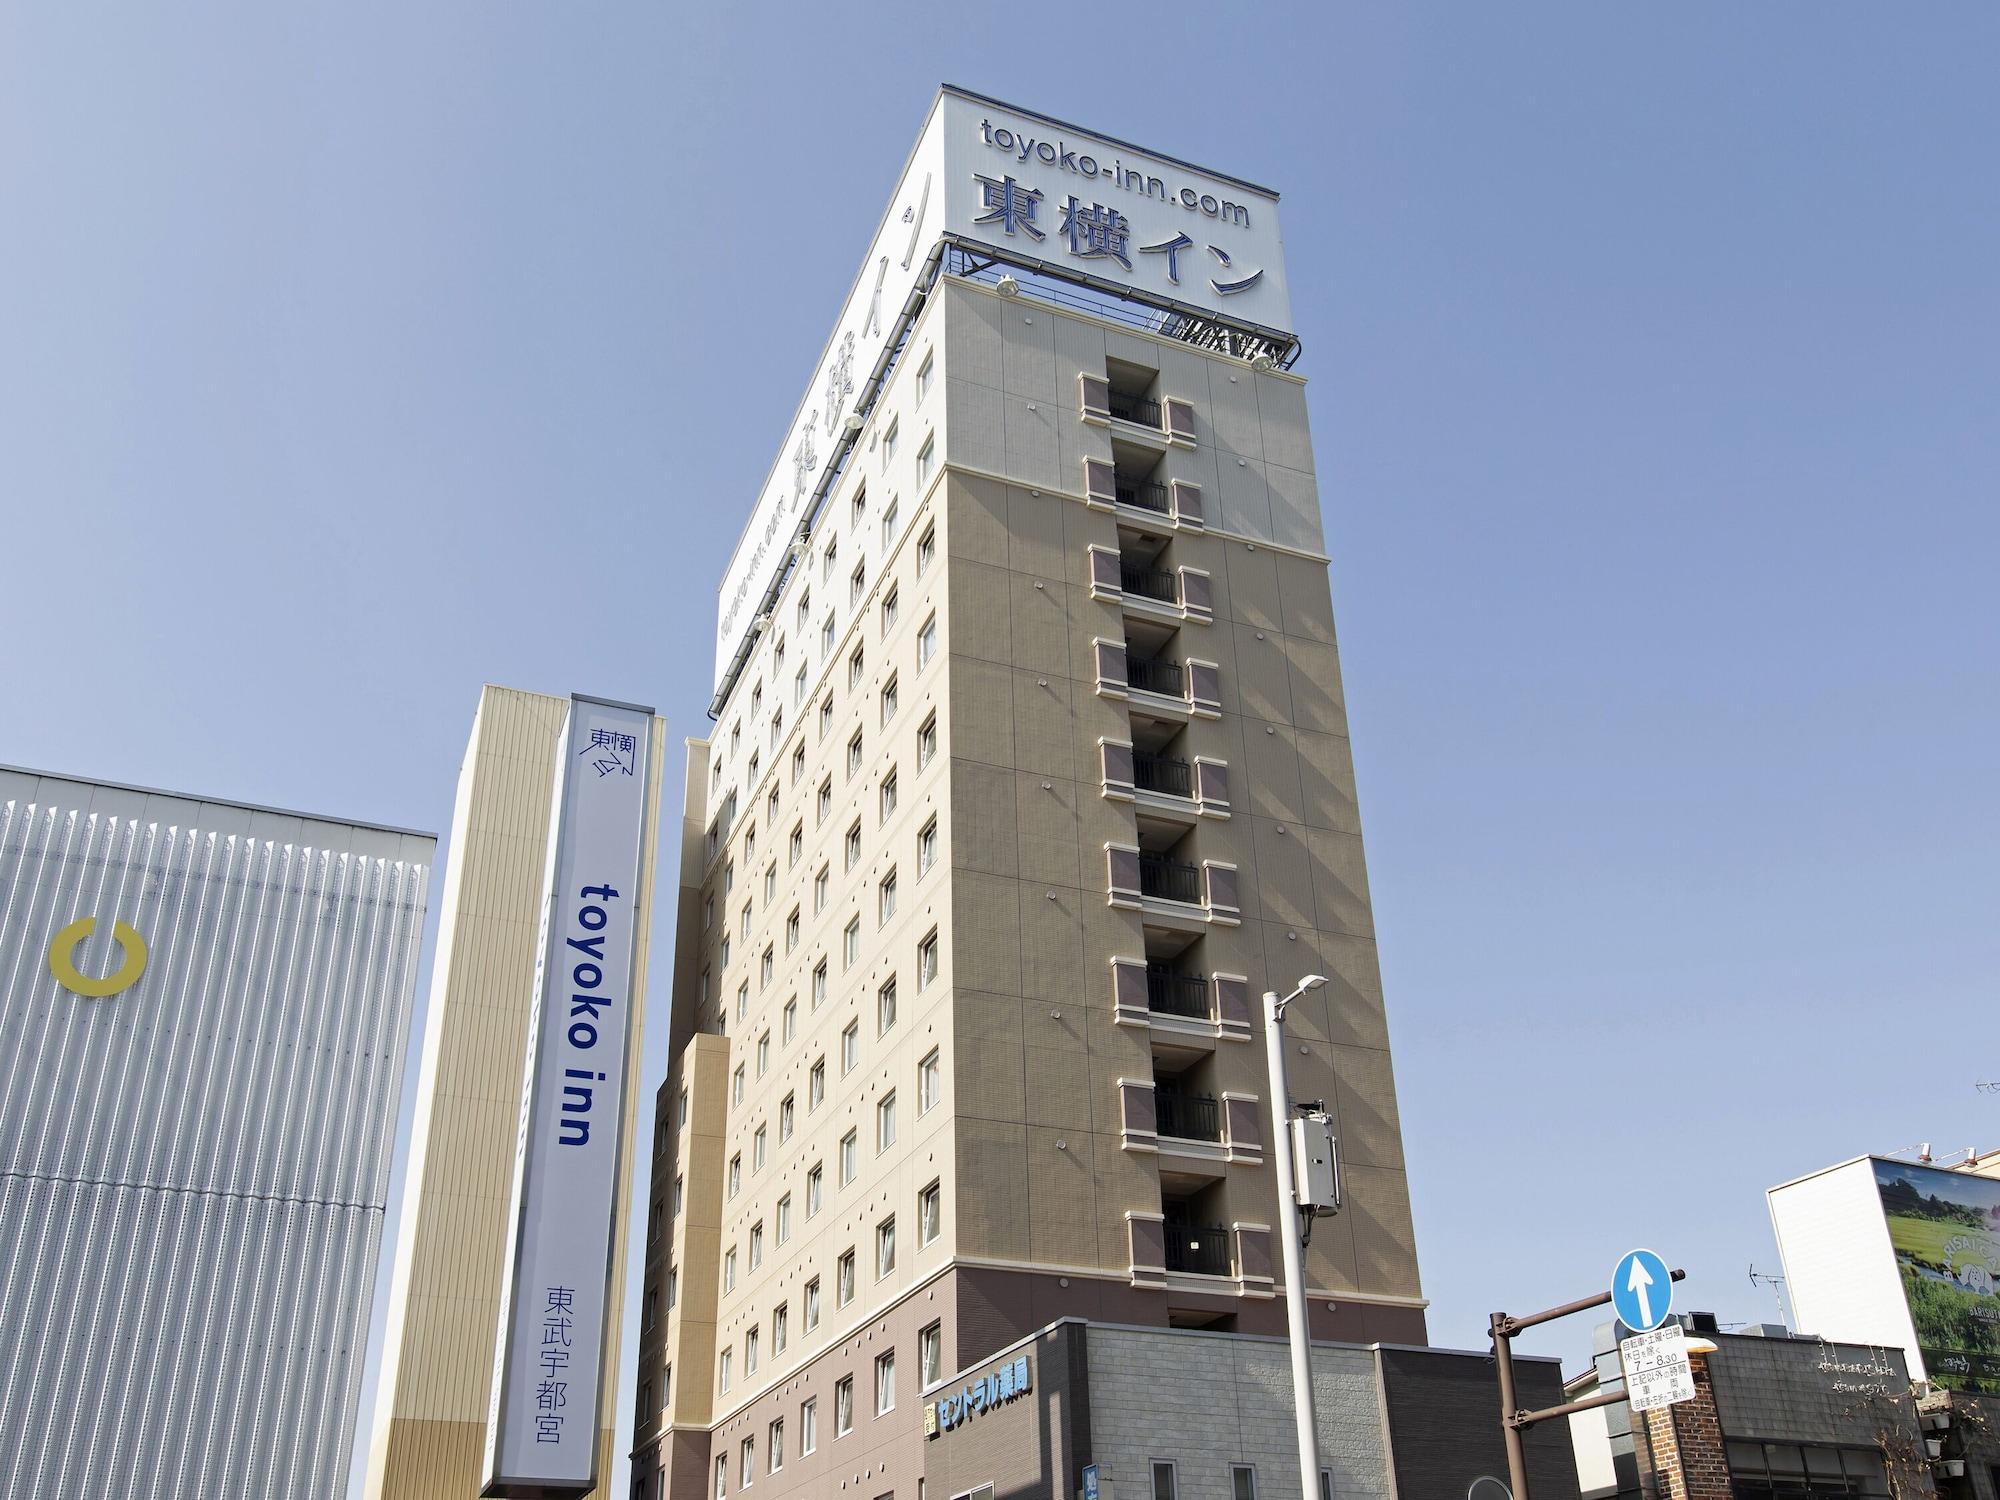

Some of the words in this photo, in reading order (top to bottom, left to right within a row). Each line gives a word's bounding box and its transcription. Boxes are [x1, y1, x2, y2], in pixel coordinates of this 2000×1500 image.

[972, 172, 1264, 297] 東横イン
[979, 118, 1251, 229] toyoko-inn.com
[566, 883, 620, 1050] toyoko
[558, 1067, 606, 1147] inn
[535, 1285, 576, 1444] 東武宇都宮
